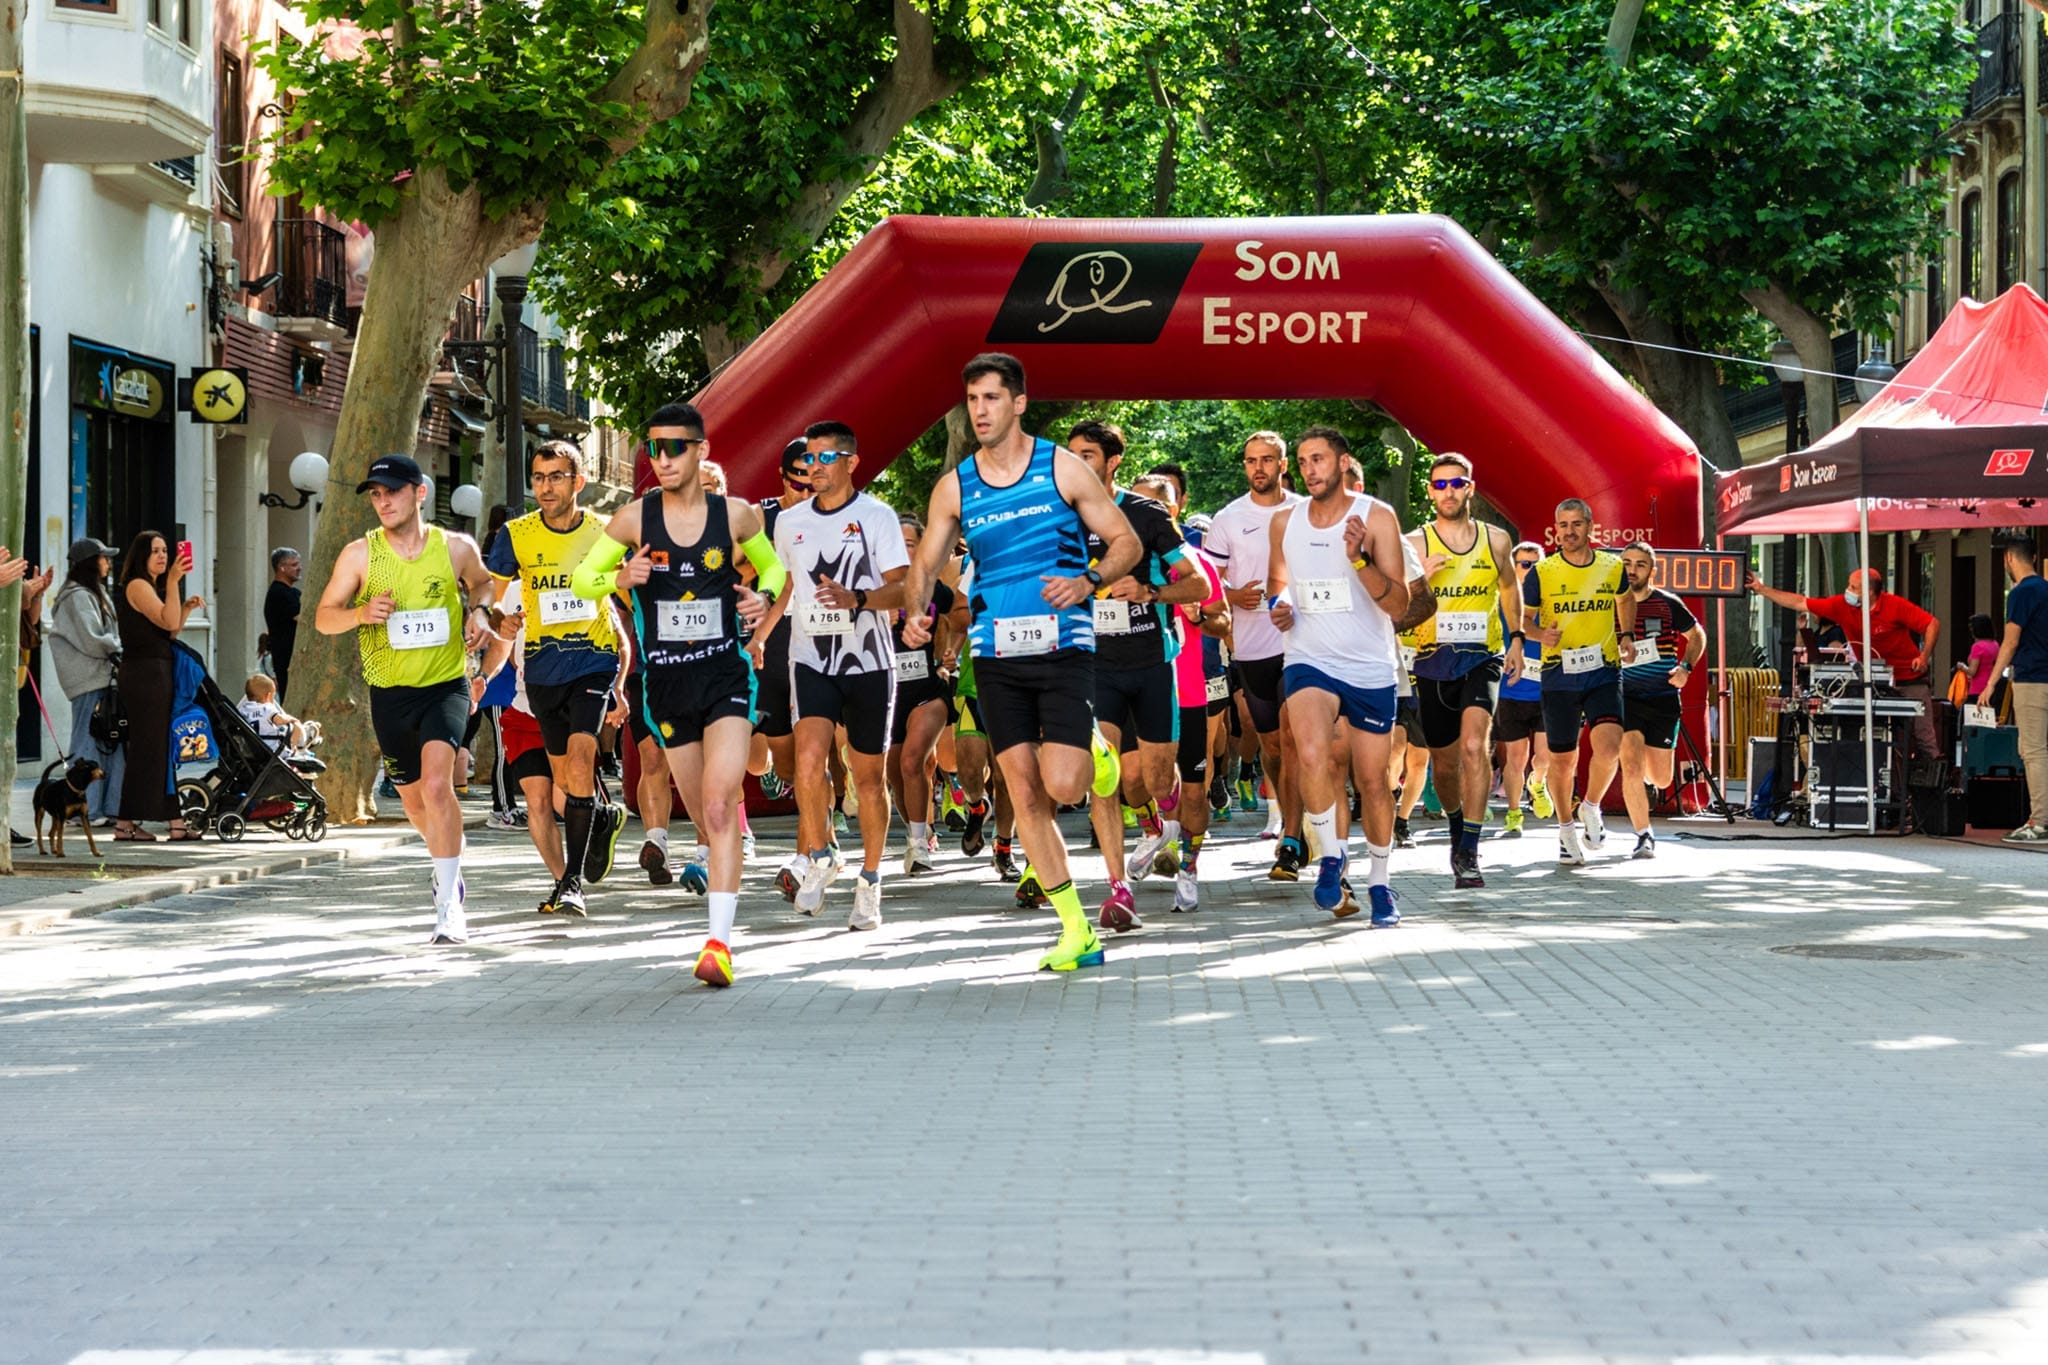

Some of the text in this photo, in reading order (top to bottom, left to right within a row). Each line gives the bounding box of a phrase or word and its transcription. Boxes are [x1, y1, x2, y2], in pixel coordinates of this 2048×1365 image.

[1312, 591, 1332, 601] A 2
[552, 599, 584, 612] B 786
[672, 614, 707, 626] S 710
[809, 613, 841, 623] A 766
[1098, 611, 1116, 621] 759
[402, 622, 434, 635] S 713
[1447, 622, 1477, 632] S 709
[1009, 629, 1042, 642] S 719
[901, 660, 920, 671] 640
